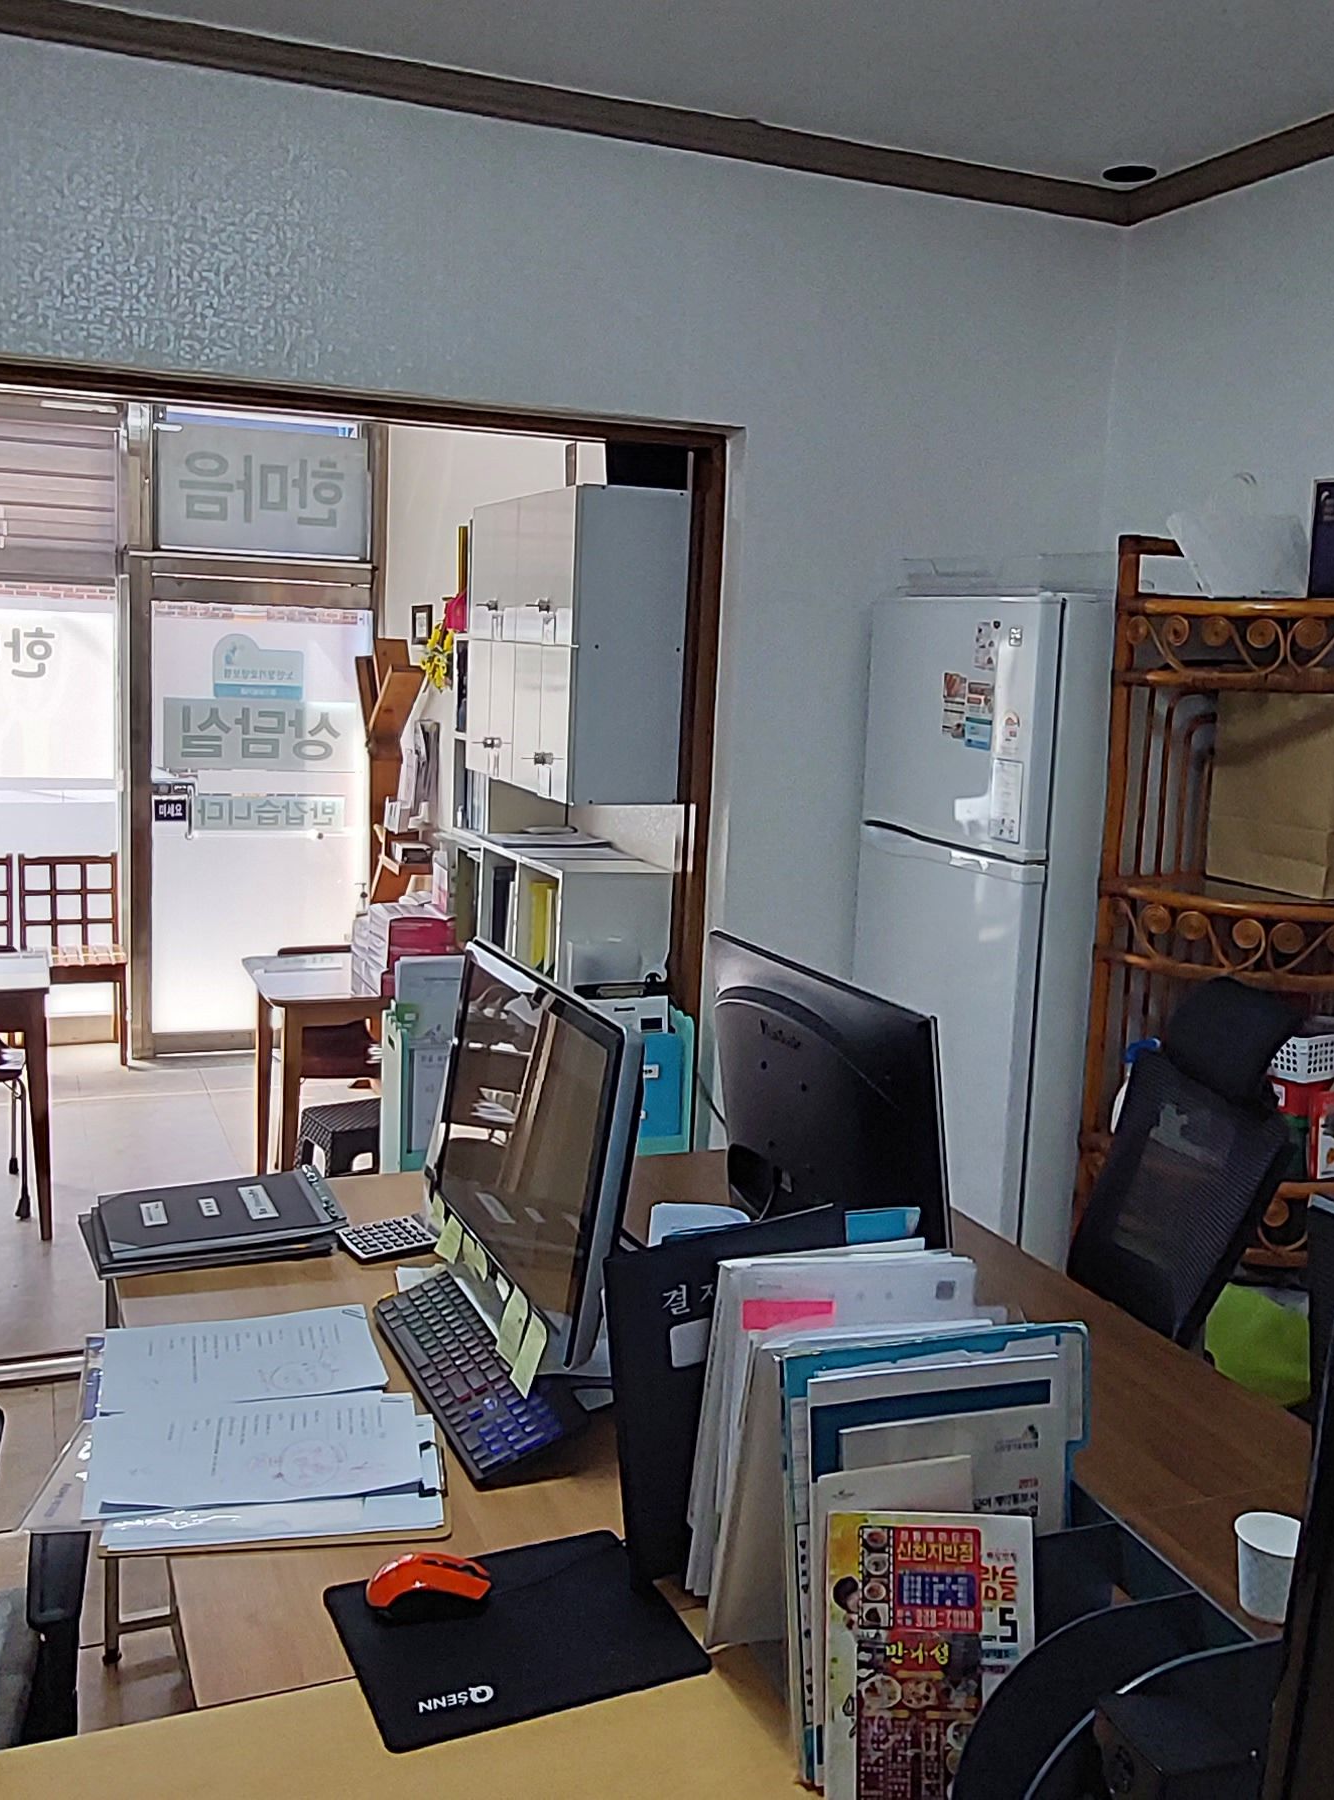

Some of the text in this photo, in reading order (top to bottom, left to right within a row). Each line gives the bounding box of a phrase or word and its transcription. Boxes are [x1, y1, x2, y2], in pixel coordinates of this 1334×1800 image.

[158, 802, 184, 818] 미세요
[898, 1542, 974, 1563] 신천지반점
[998, 1606, 1019, 1644] 5
[418, 1684, 495, 1714] QSENN
